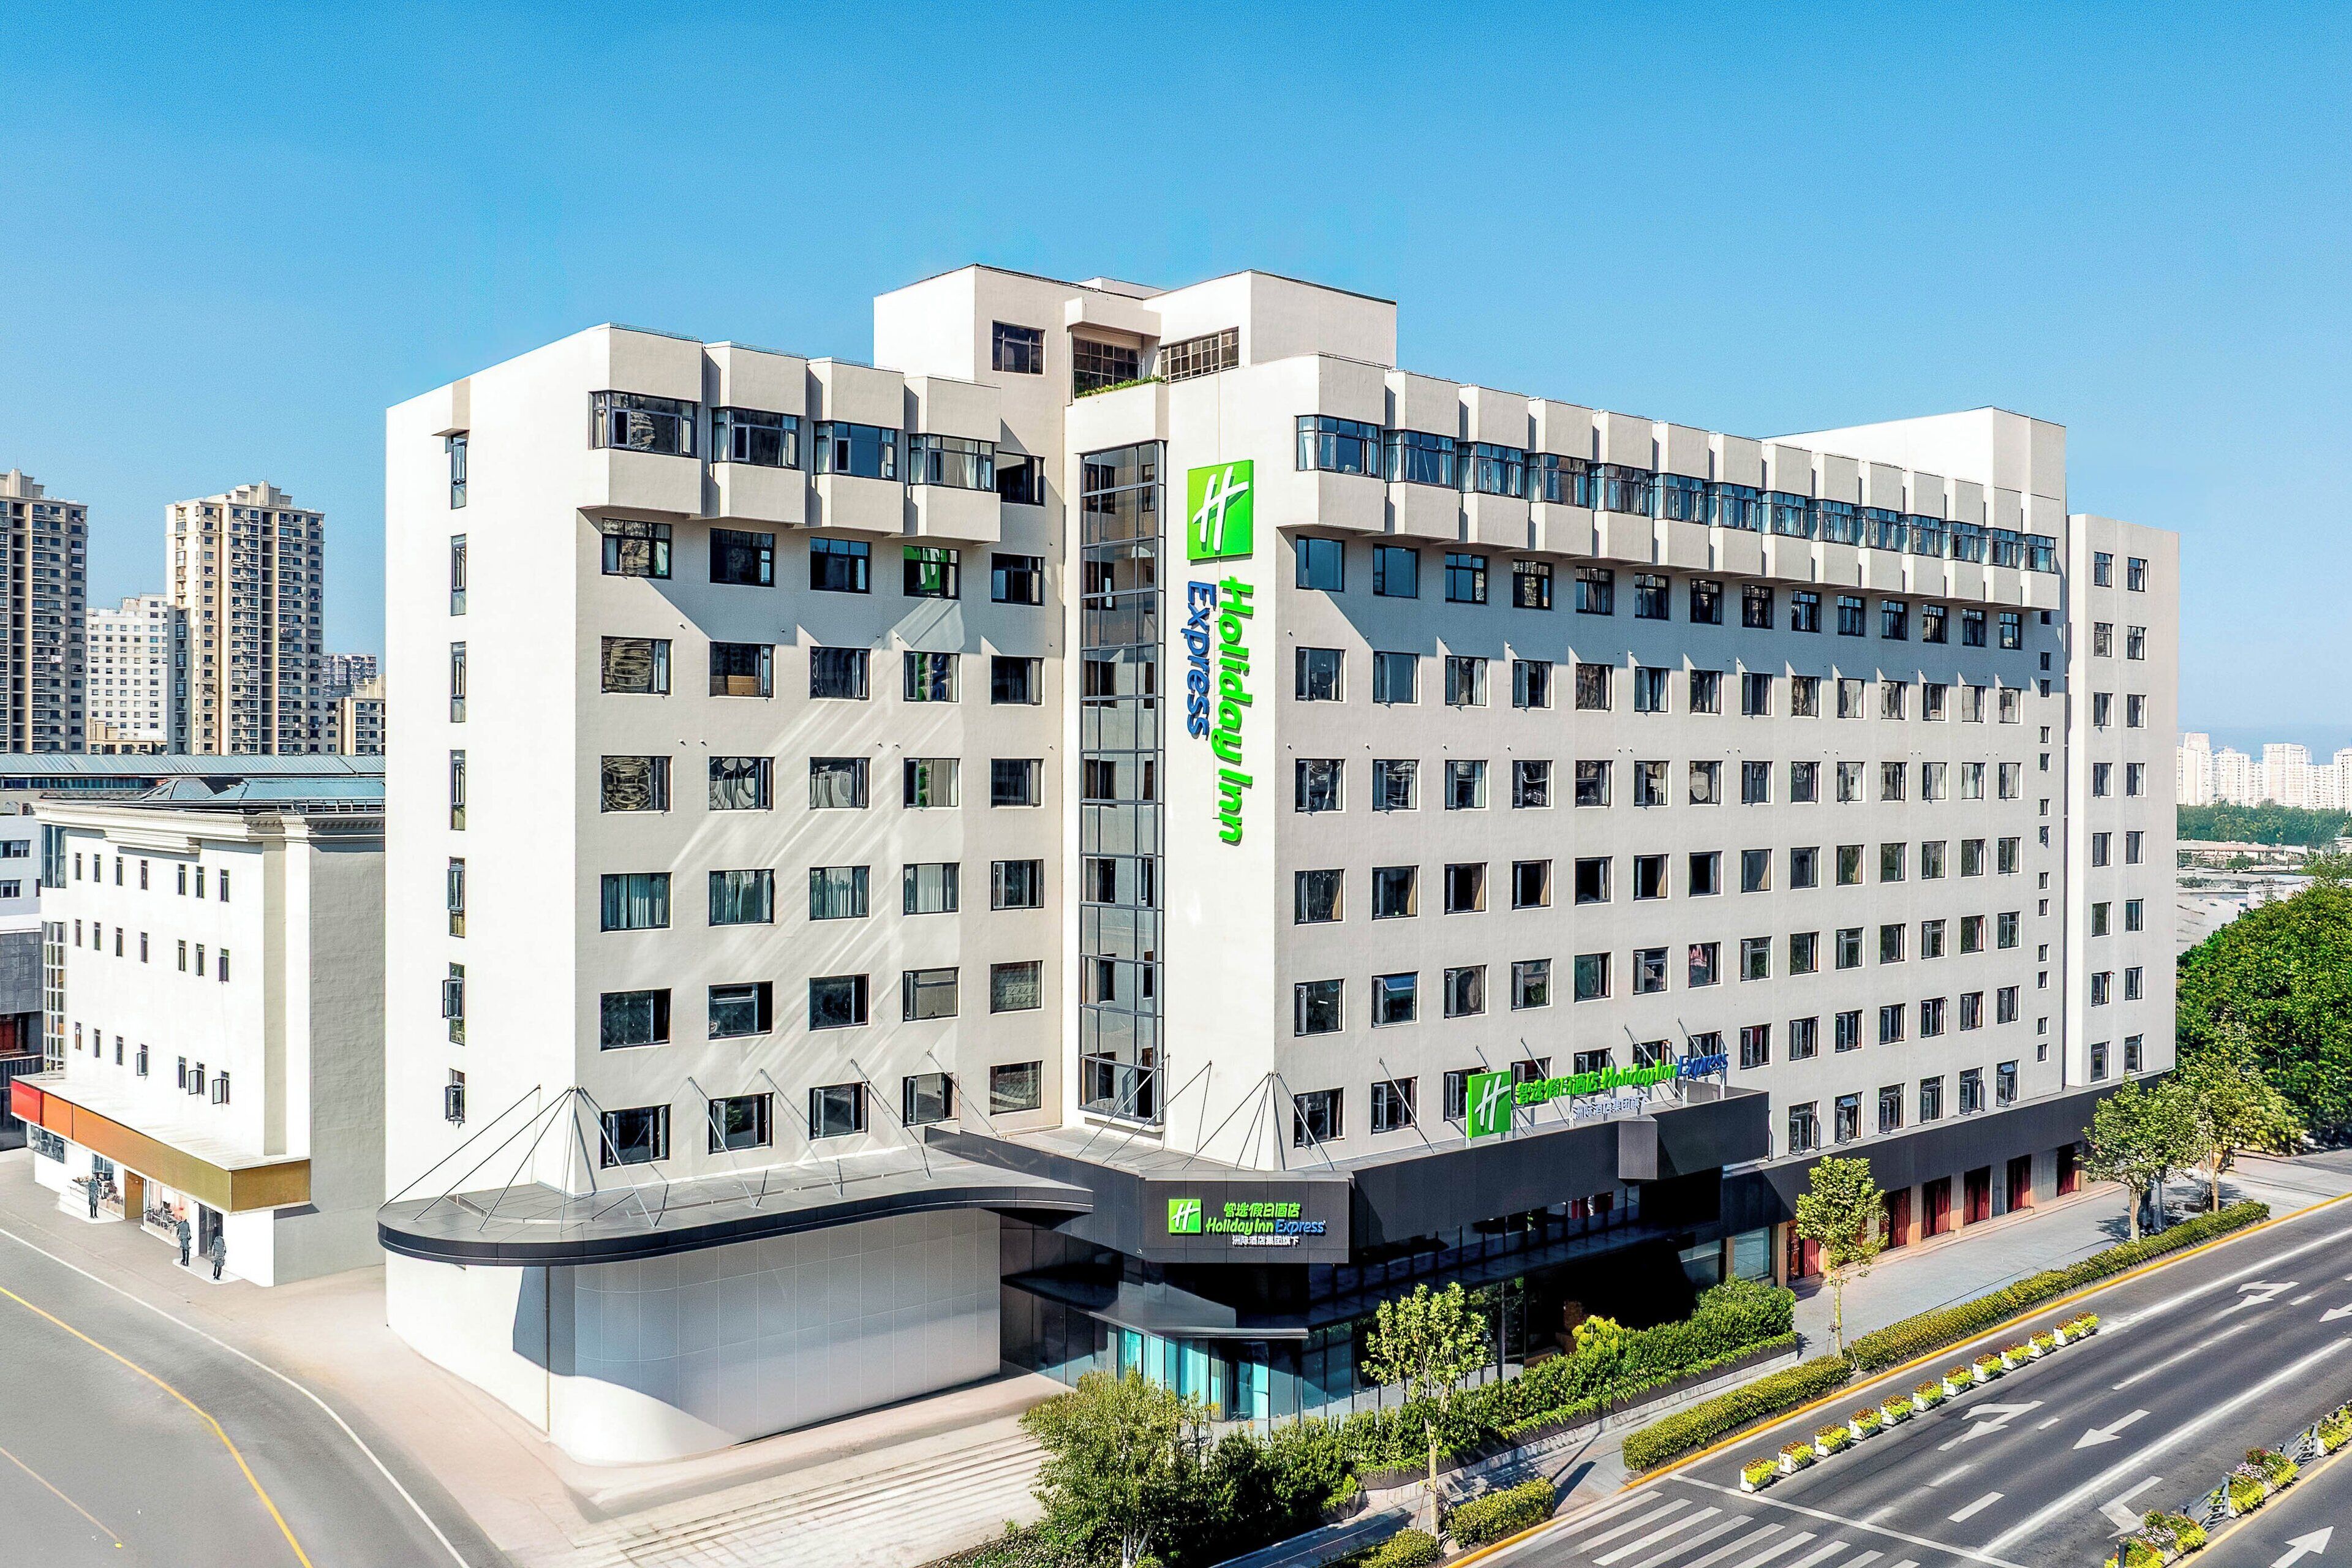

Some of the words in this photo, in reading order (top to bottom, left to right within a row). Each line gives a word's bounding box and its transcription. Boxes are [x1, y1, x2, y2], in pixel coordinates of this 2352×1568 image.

[1181, 580, 1216, 739] Express
[1211, 576, 1253, 762] Holiday
[1219, 769, 1253, 845] Inn
[1515, 1071, 1599, 1104] 智选假日酒店
[1600, 1063, 1655, 1090] Holiday
[1654, 1059, 1678, 1081] Inn
[1676, 1054, 1728, 1080] Express
[1205, 1217, 1253, 1235] Holiday
[1254, 1218, 1274, 1233] Inn
[1275, 1219, 1324, 1235] Express
[1224, 1202, 1300, 1218] 智选假日酒店
[1232, 1235, 1299, 1246] 洲际酒店集团旗下
